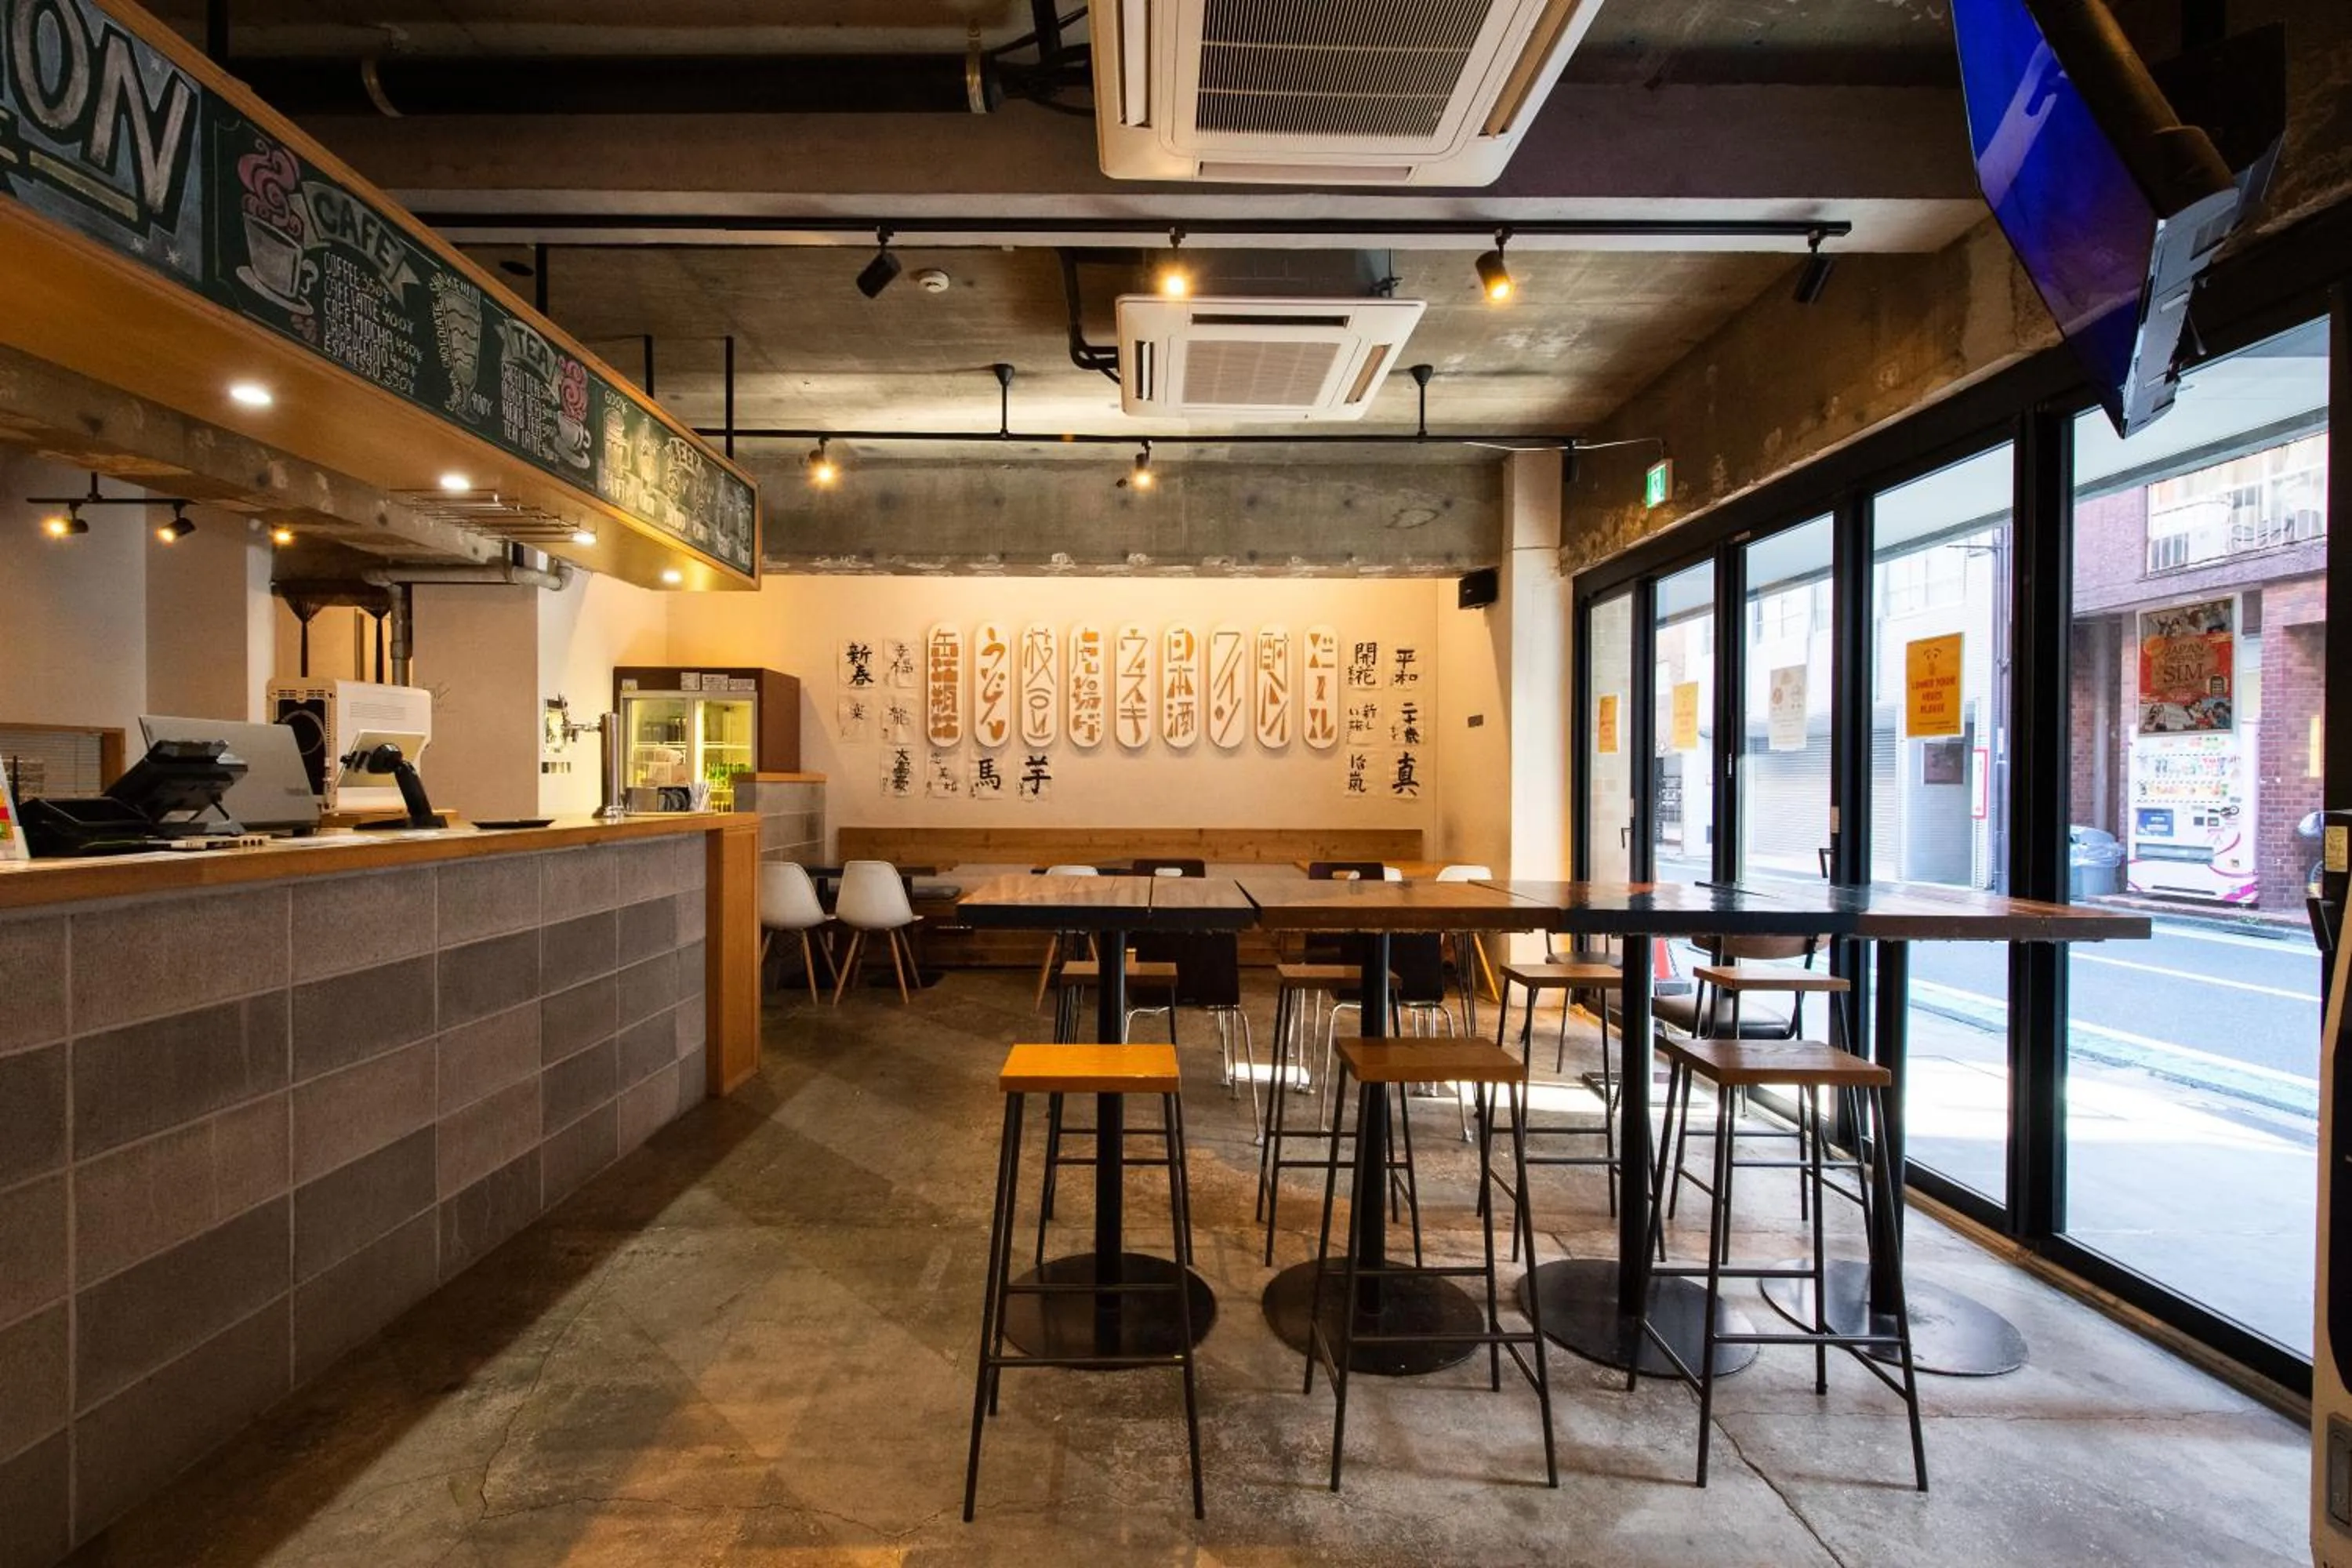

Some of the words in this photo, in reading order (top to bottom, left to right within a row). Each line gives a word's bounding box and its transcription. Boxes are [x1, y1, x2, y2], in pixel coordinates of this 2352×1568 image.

[314, 191, 394, 268] CAFE
[324, 251, 361, 290] COFFEE
[324, 275, 352, 307] CAFE
[324, 297, 351, 327] CAFE
[353, 314, 394, 352] MOCHA
[514, 324, 550, 374] TEA
[1355, 642, 1377, 686] 開花
[1395, 649, 1419, 685] 平和
[2166, 641, 2205, 656] JAPAN
[1167, 629, 1194, 738] 日本酒
[1214, 632, 1242, 742] ワイン
[1308, 633, 1335, 739] ビール
[2163, 663, 2204, 684] SIM
[975, 758, 1001, 791] 馬
[1392, 750, 1420, 797] 真
